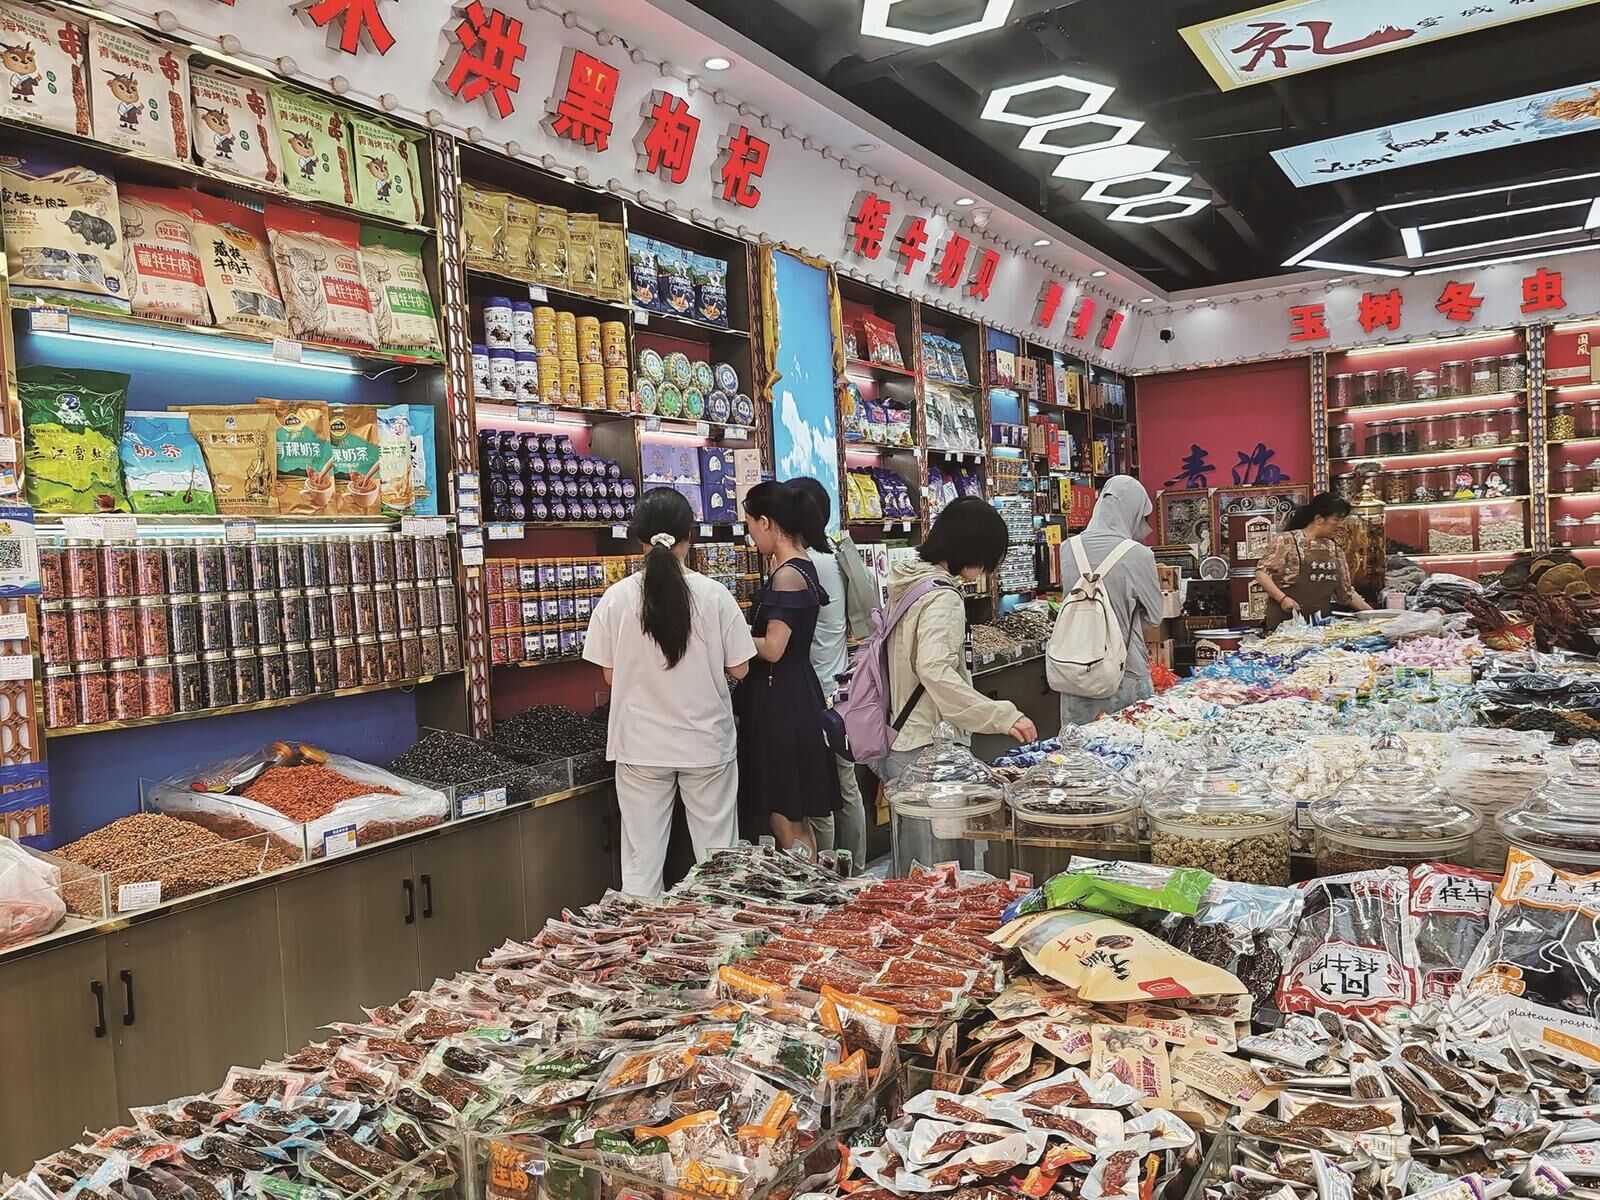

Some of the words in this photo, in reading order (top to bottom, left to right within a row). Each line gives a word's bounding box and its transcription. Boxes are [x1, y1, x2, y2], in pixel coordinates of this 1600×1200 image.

[0, 16, 52, 46] 海烤羊肉
[58, 22, 83, 60] 串
[98, 45, 154, 74] 青海烤羊肉
[1230, 20, 1417, 72] 礼
[158, 50, 181, 87] 串
[246, 88, 267, 120] 串
[279, 111, 323, 133] 青海烤羊肉
[212, 239, 246, 262] 藏牦
[854, 192, 1001, 302] 牦牛奶贝
[137, 249, 200, 276] 藏牦牛肉干
[213, 256, 251, 276] 牛肉干
[1289, 267, 1567, 342] 玉树冬虫
[134, 443, 183, 460] 奶茶
[1163, 442, 1291, 488] 青海
[1439, 886, 1492, 904] 牦牛
[1508, 1007, 1557, 1022] plateau
